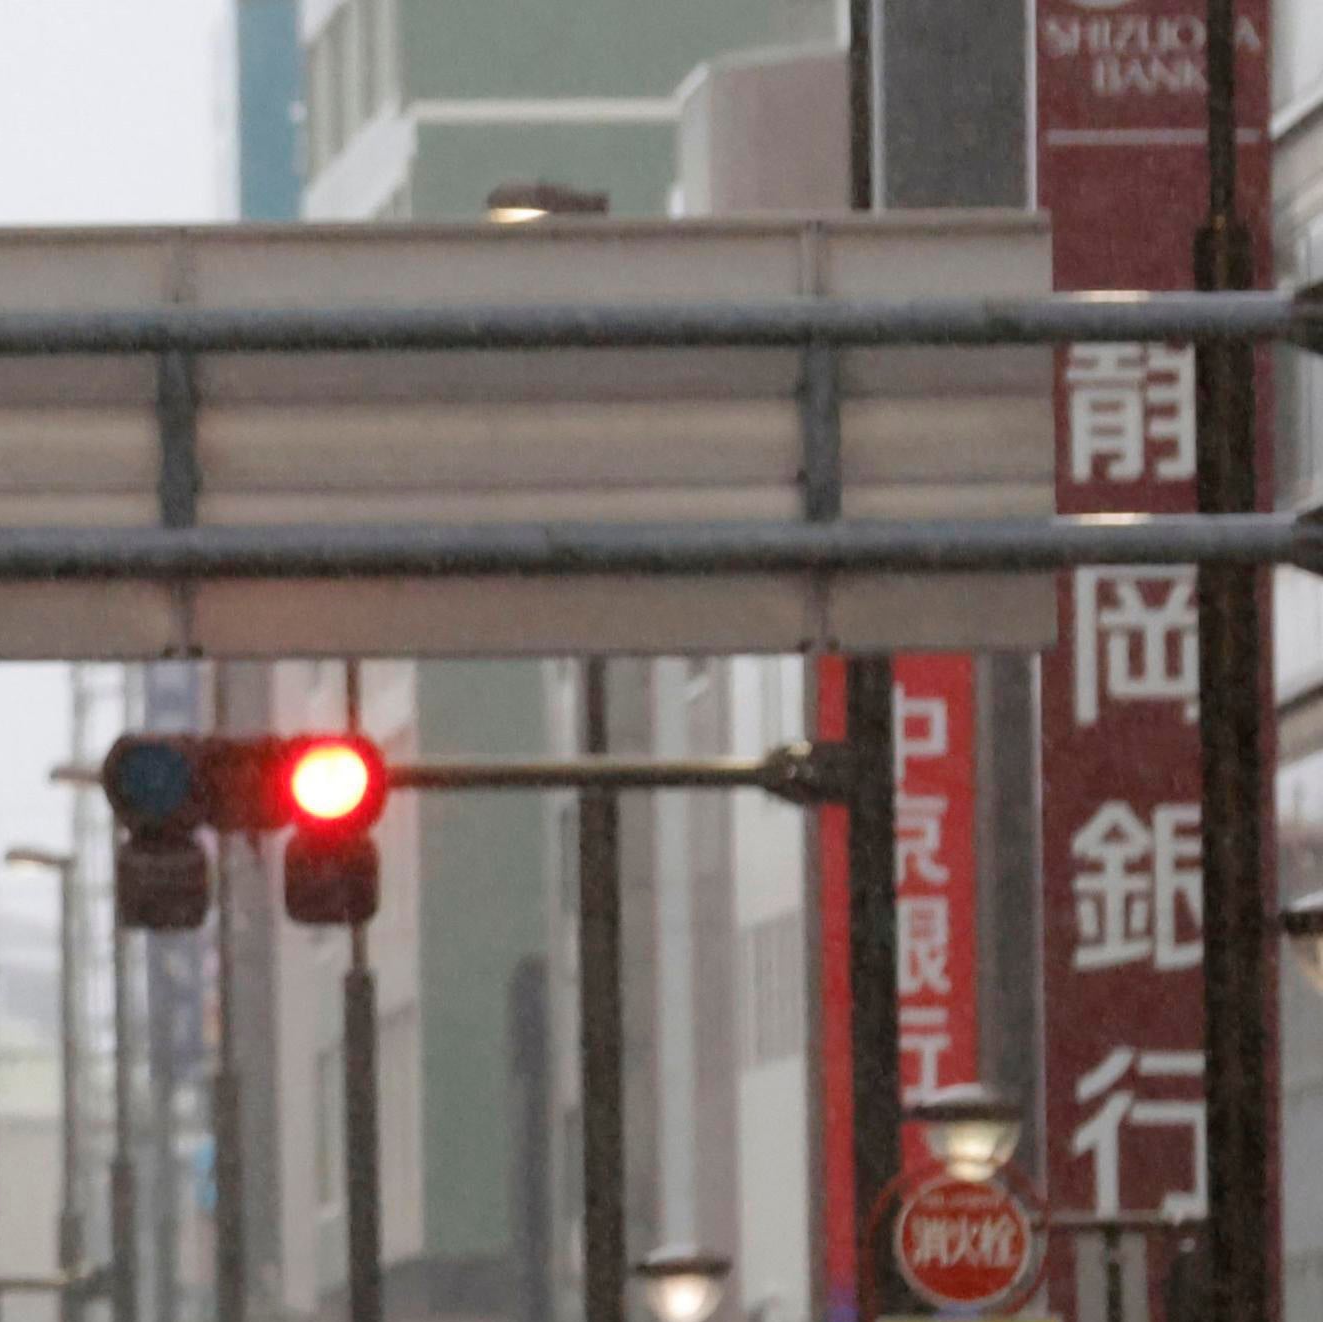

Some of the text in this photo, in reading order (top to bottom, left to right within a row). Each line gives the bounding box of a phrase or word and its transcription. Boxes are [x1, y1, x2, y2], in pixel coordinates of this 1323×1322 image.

[1046, 14, 1262, 55] SHIZUOA
[1091, 57, 1211, 95] BANK
[910, 1212, 1019, 1268] 消火栓
